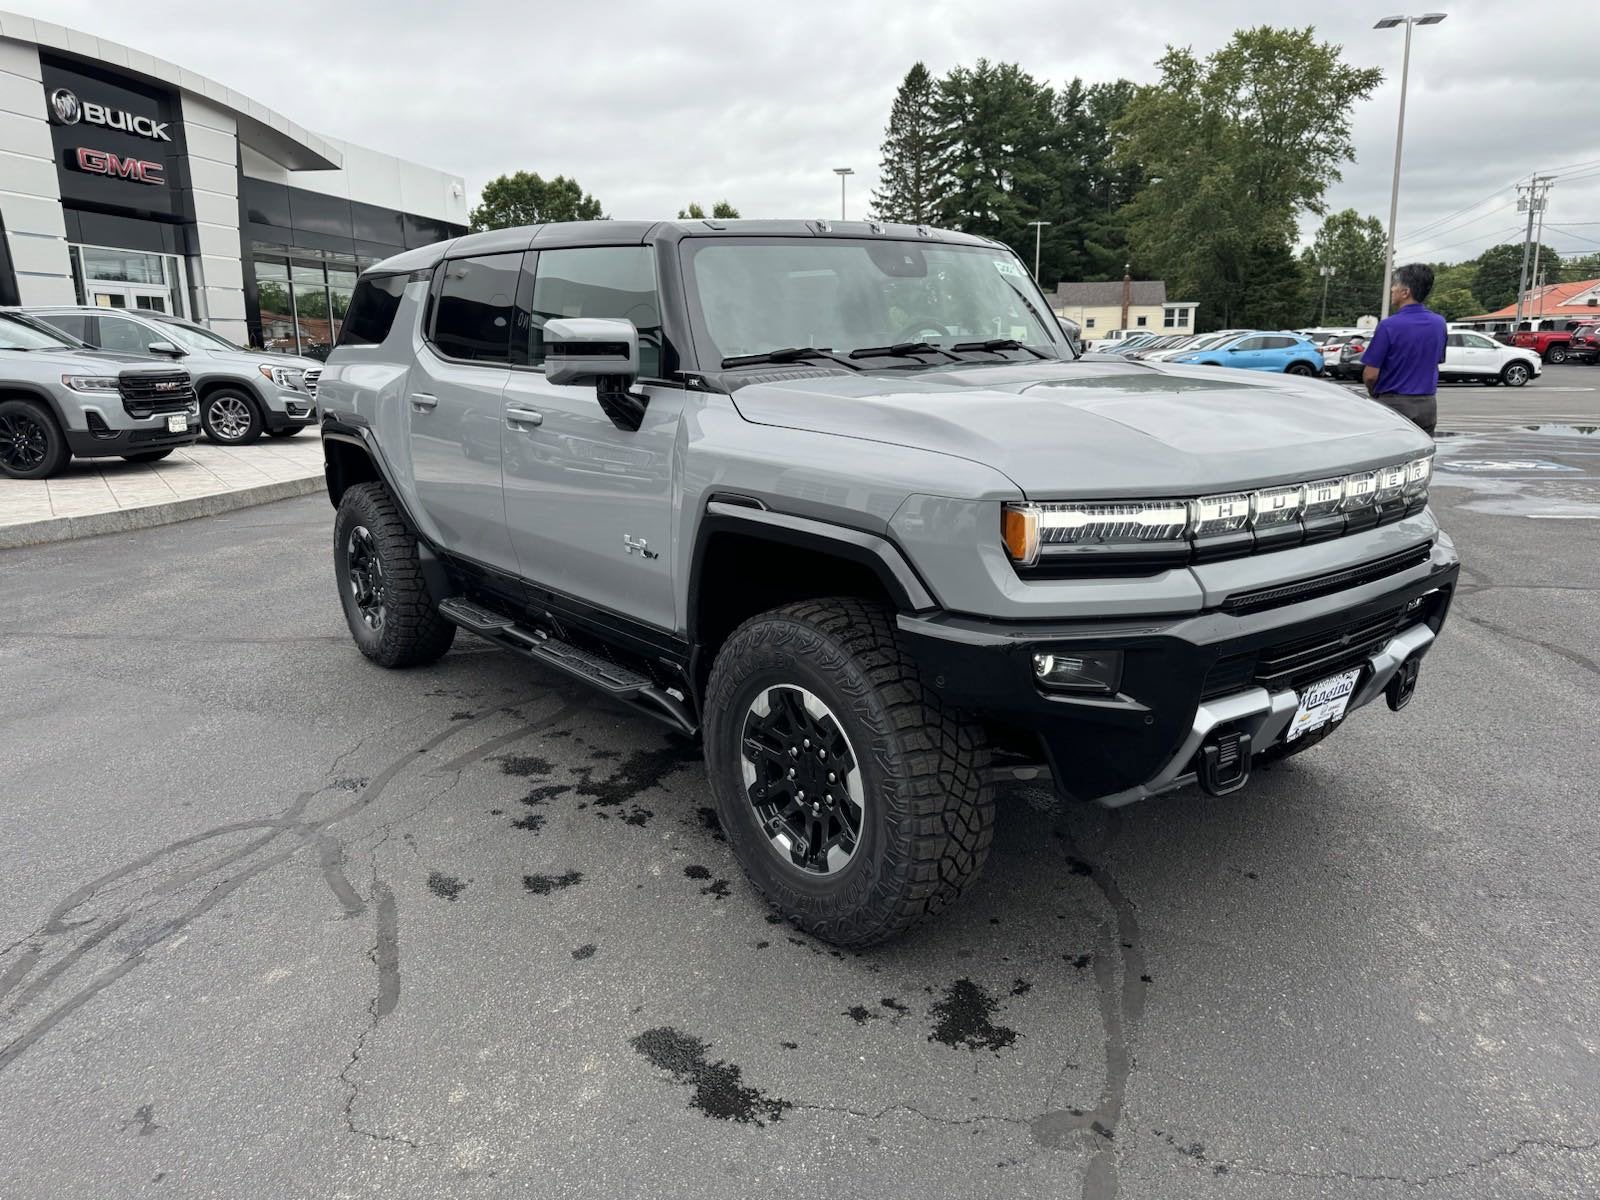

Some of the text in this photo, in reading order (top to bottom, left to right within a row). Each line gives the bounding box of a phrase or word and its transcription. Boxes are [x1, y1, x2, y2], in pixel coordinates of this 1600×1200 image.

[82, 101, 172, 142] BUICK
[77, 147, 165, 185] GMC
[1217, 467, 1427, 518] HUMMER
